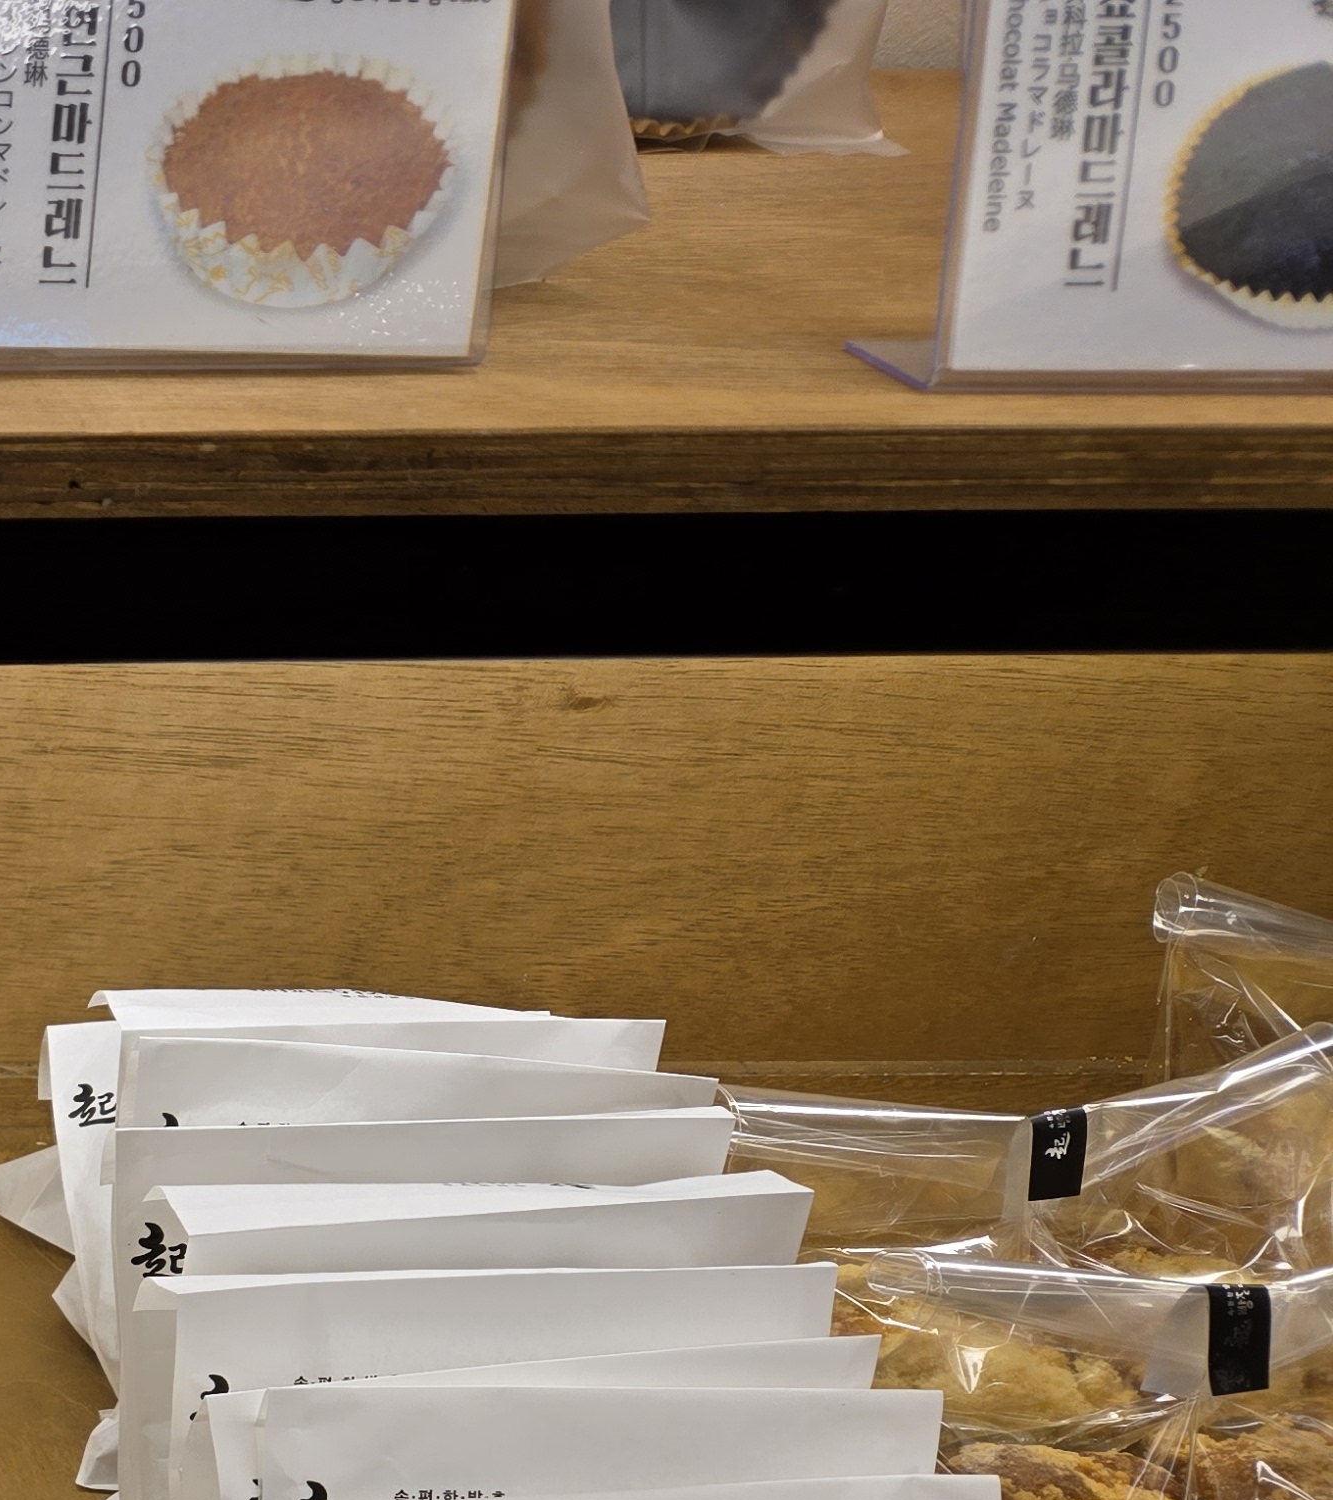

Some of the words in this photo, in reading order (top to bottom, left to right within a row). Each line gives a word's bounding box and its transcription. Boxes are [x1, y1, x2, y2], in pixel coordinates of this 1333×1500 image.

[998, 0, 1025, 92] hocolat
[1154, 0, 1185, 107] 500
[983, 102, 1018, 233] Madeleine
[1014, 8, 1059, 210] ョコラマドレーヌ
